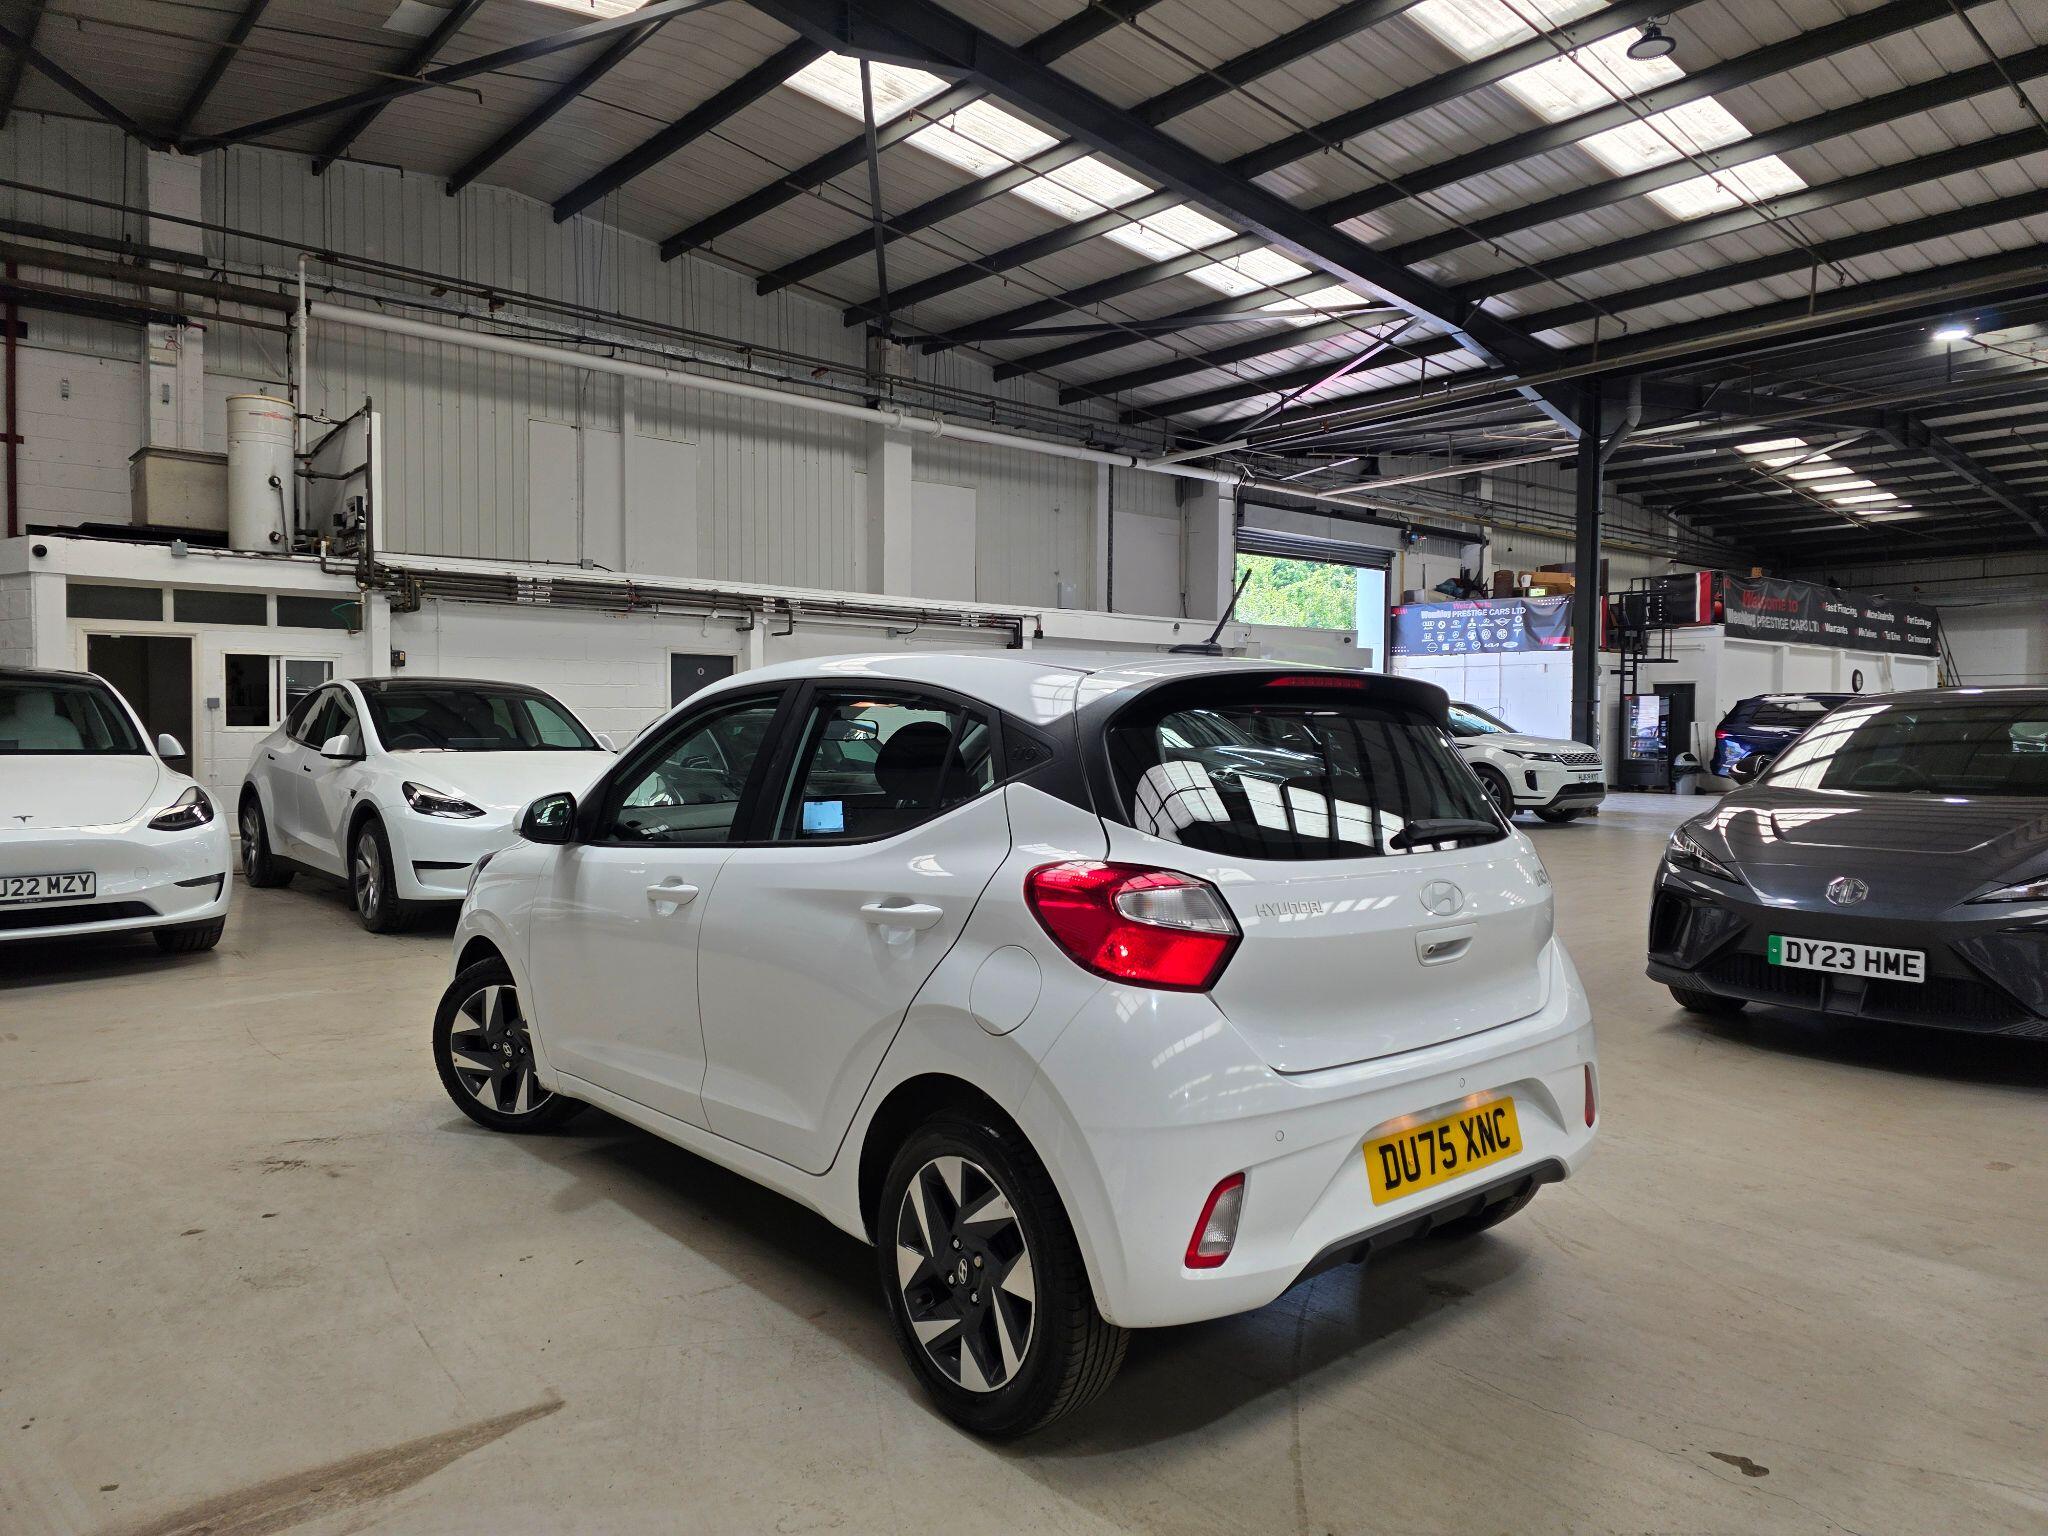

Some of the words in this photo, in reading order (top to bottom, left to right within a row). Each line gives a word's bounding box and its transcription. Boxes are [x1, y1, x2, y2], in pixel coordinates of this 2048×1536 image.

[1757, 615, 1789, 630] PRESTIGE
[46, 874, 91, 895] MZY
[1255, 899, 1324, 918] HYUNDAI
[1786, 940, 1856, 970] DY23
[1864, 949, 1921, 978] HME
[1378, 1125, 1458, 1191] DU75
[1459, 1107, 1511, 1163] XNC
